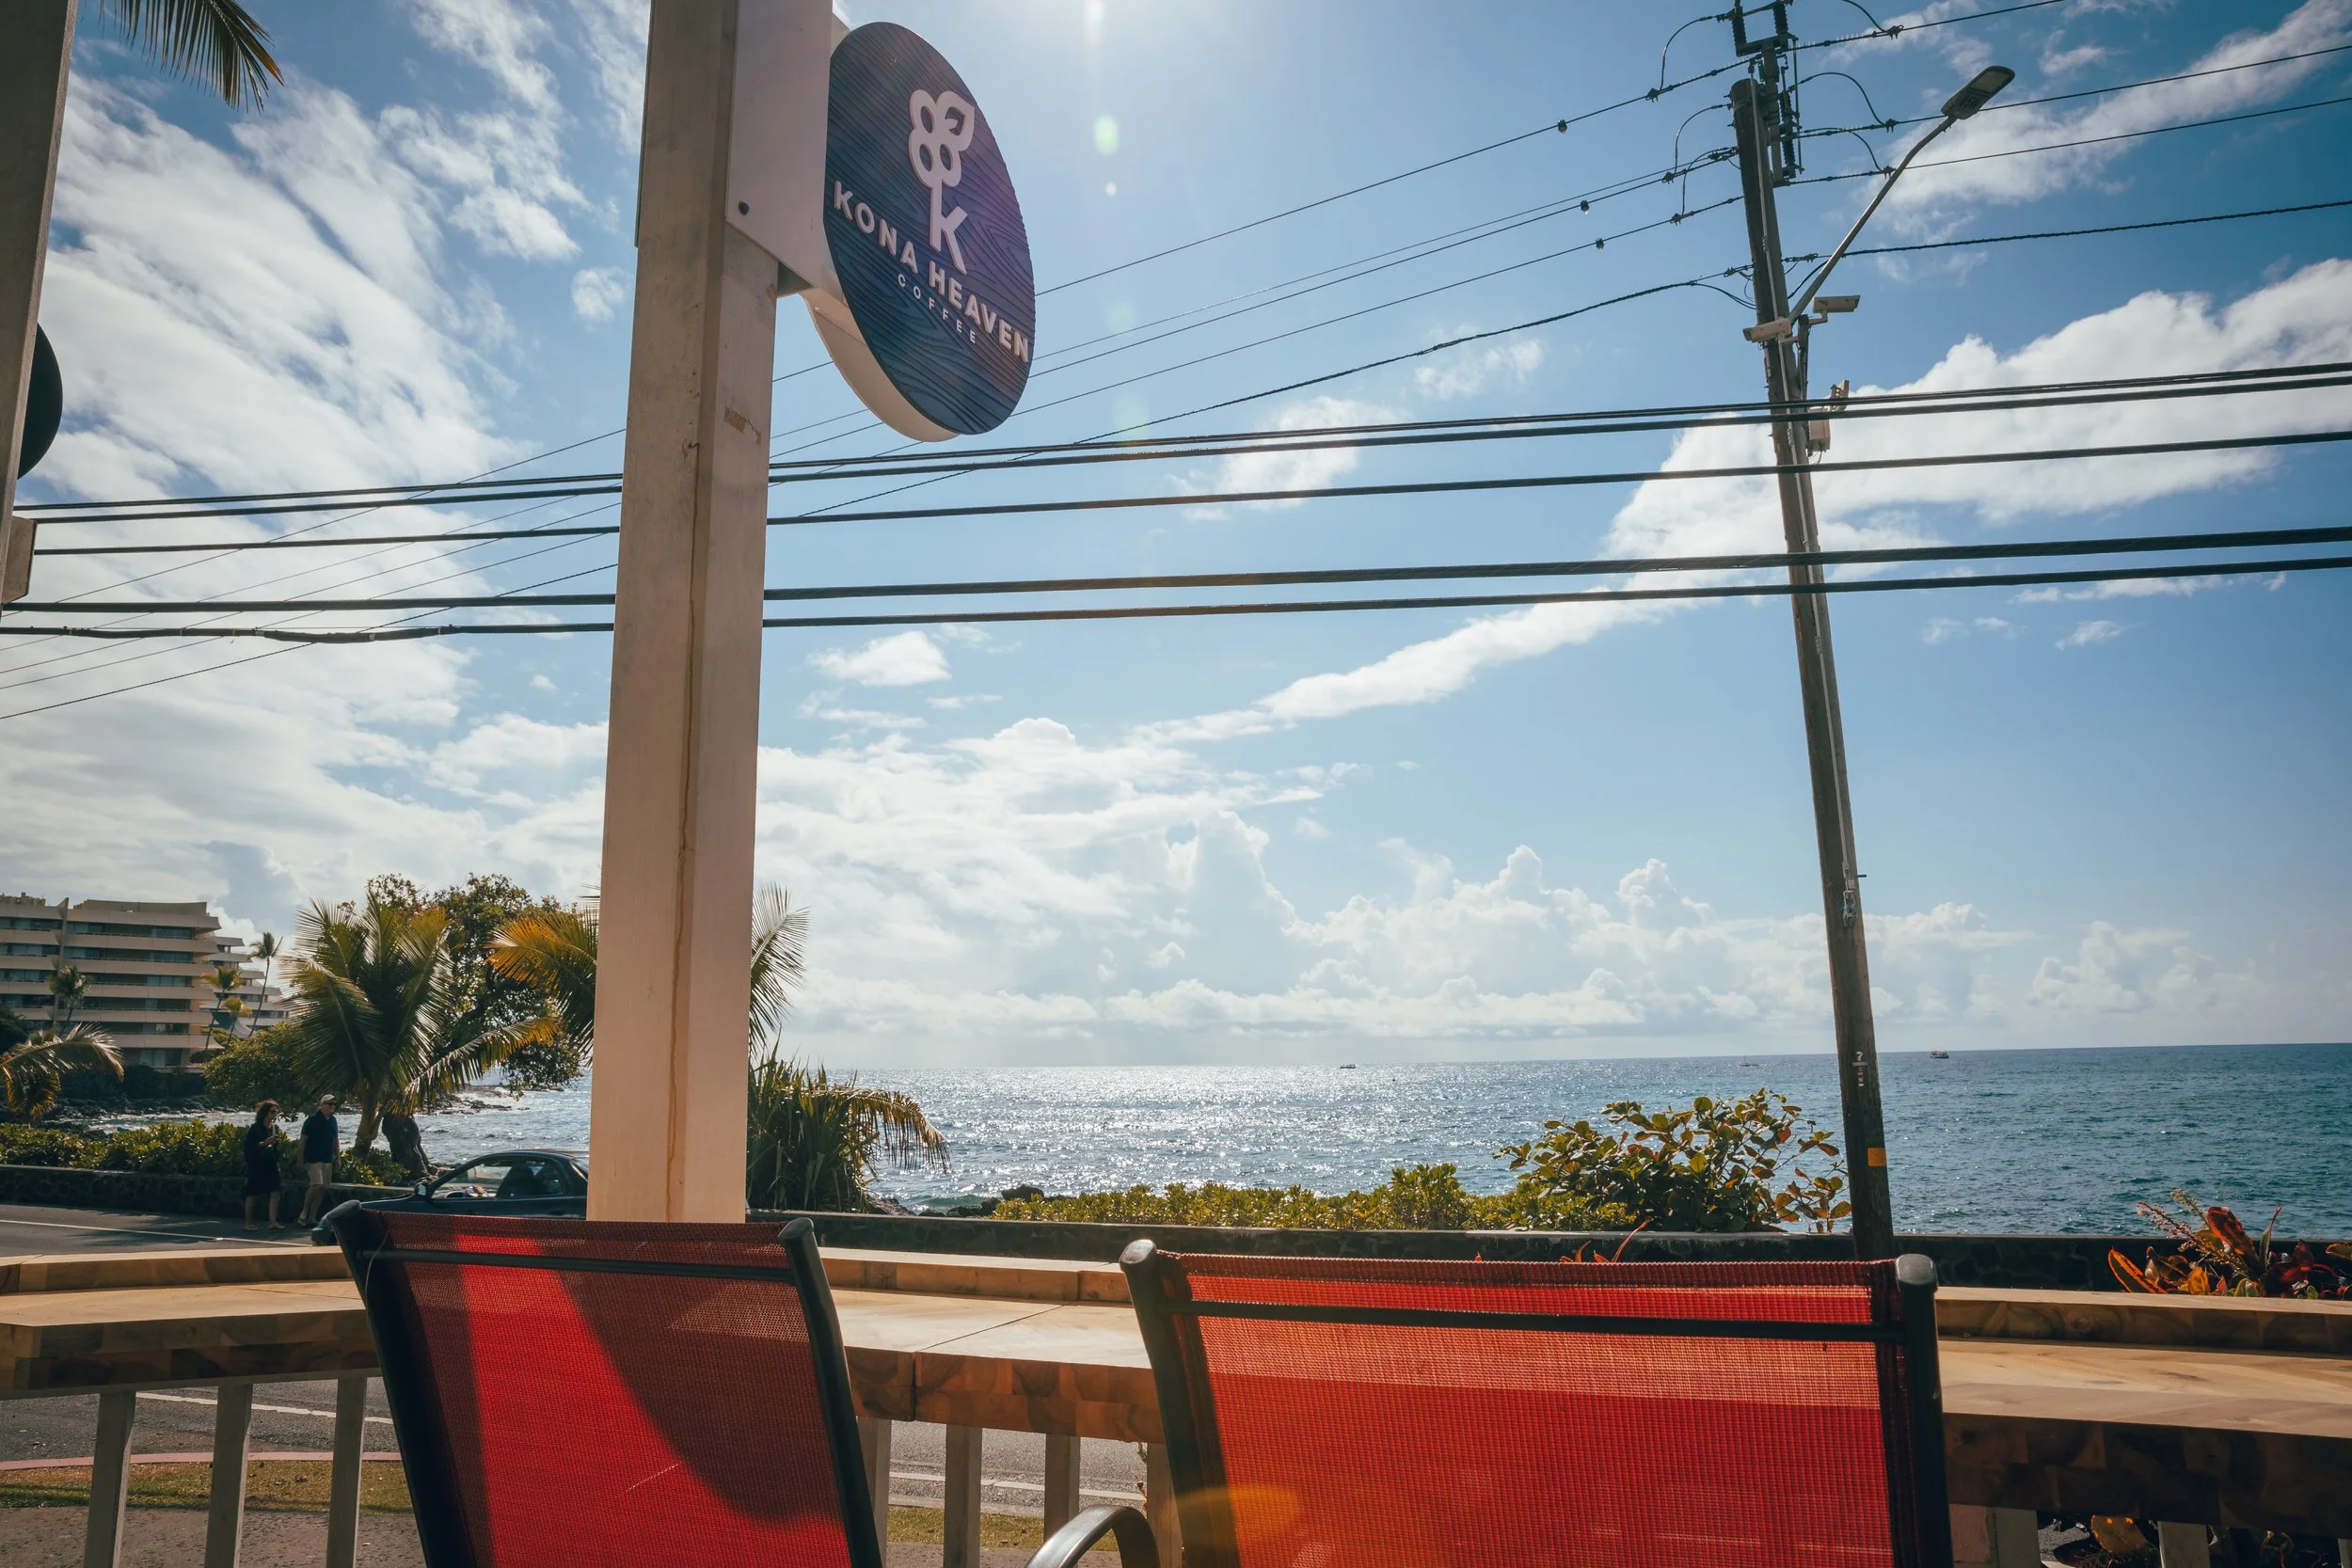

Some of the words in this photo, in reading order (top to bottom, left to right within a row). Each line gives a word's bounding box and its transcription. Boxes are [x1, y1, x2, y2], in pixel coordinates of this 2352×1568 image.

[834, 180, 918, 274] KONA
[929, 260, 1029, 363] HEAVEN
[898, 273, 976, 344] COFFEE
